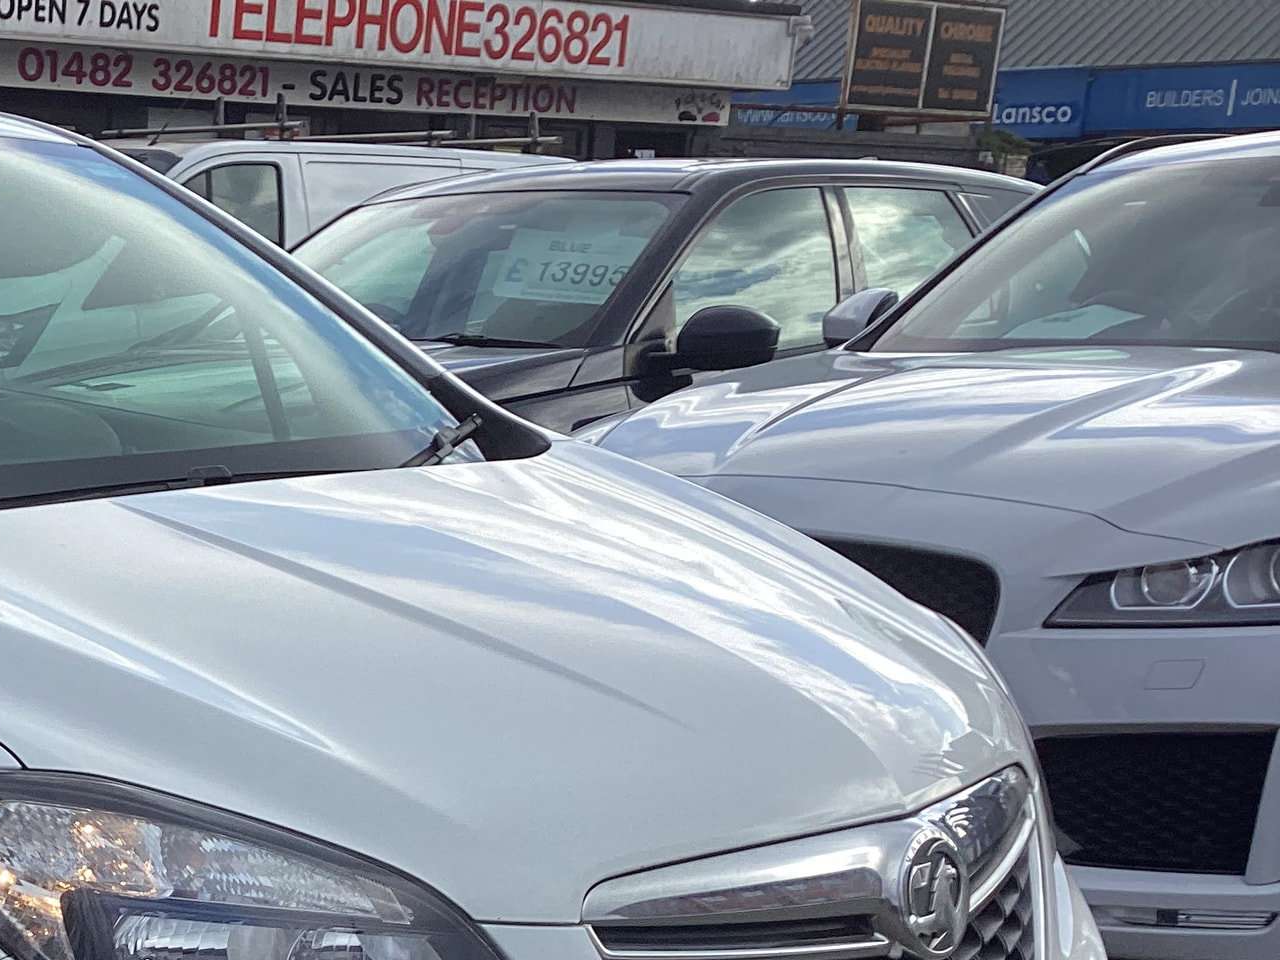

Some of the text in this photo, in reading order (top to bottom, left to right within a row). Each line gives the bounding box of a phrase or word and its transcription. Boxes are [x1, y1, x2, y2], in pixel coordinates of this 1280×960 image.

[77, 0, 90, 26] 7
[99, 1, 160, 32] DAYS
[865, 15, 925, 36] QUALITY
[17, 47, 134, 87] 01482
[151, 57, 269, 97] 326821
[309, 69, 404, 104] SALES
[416, 76, 577, 113] RECEPTION
[1145, 88, 1280, 108] BUILDERS JOIN
[992, 103, 1072, 124] Lansco
